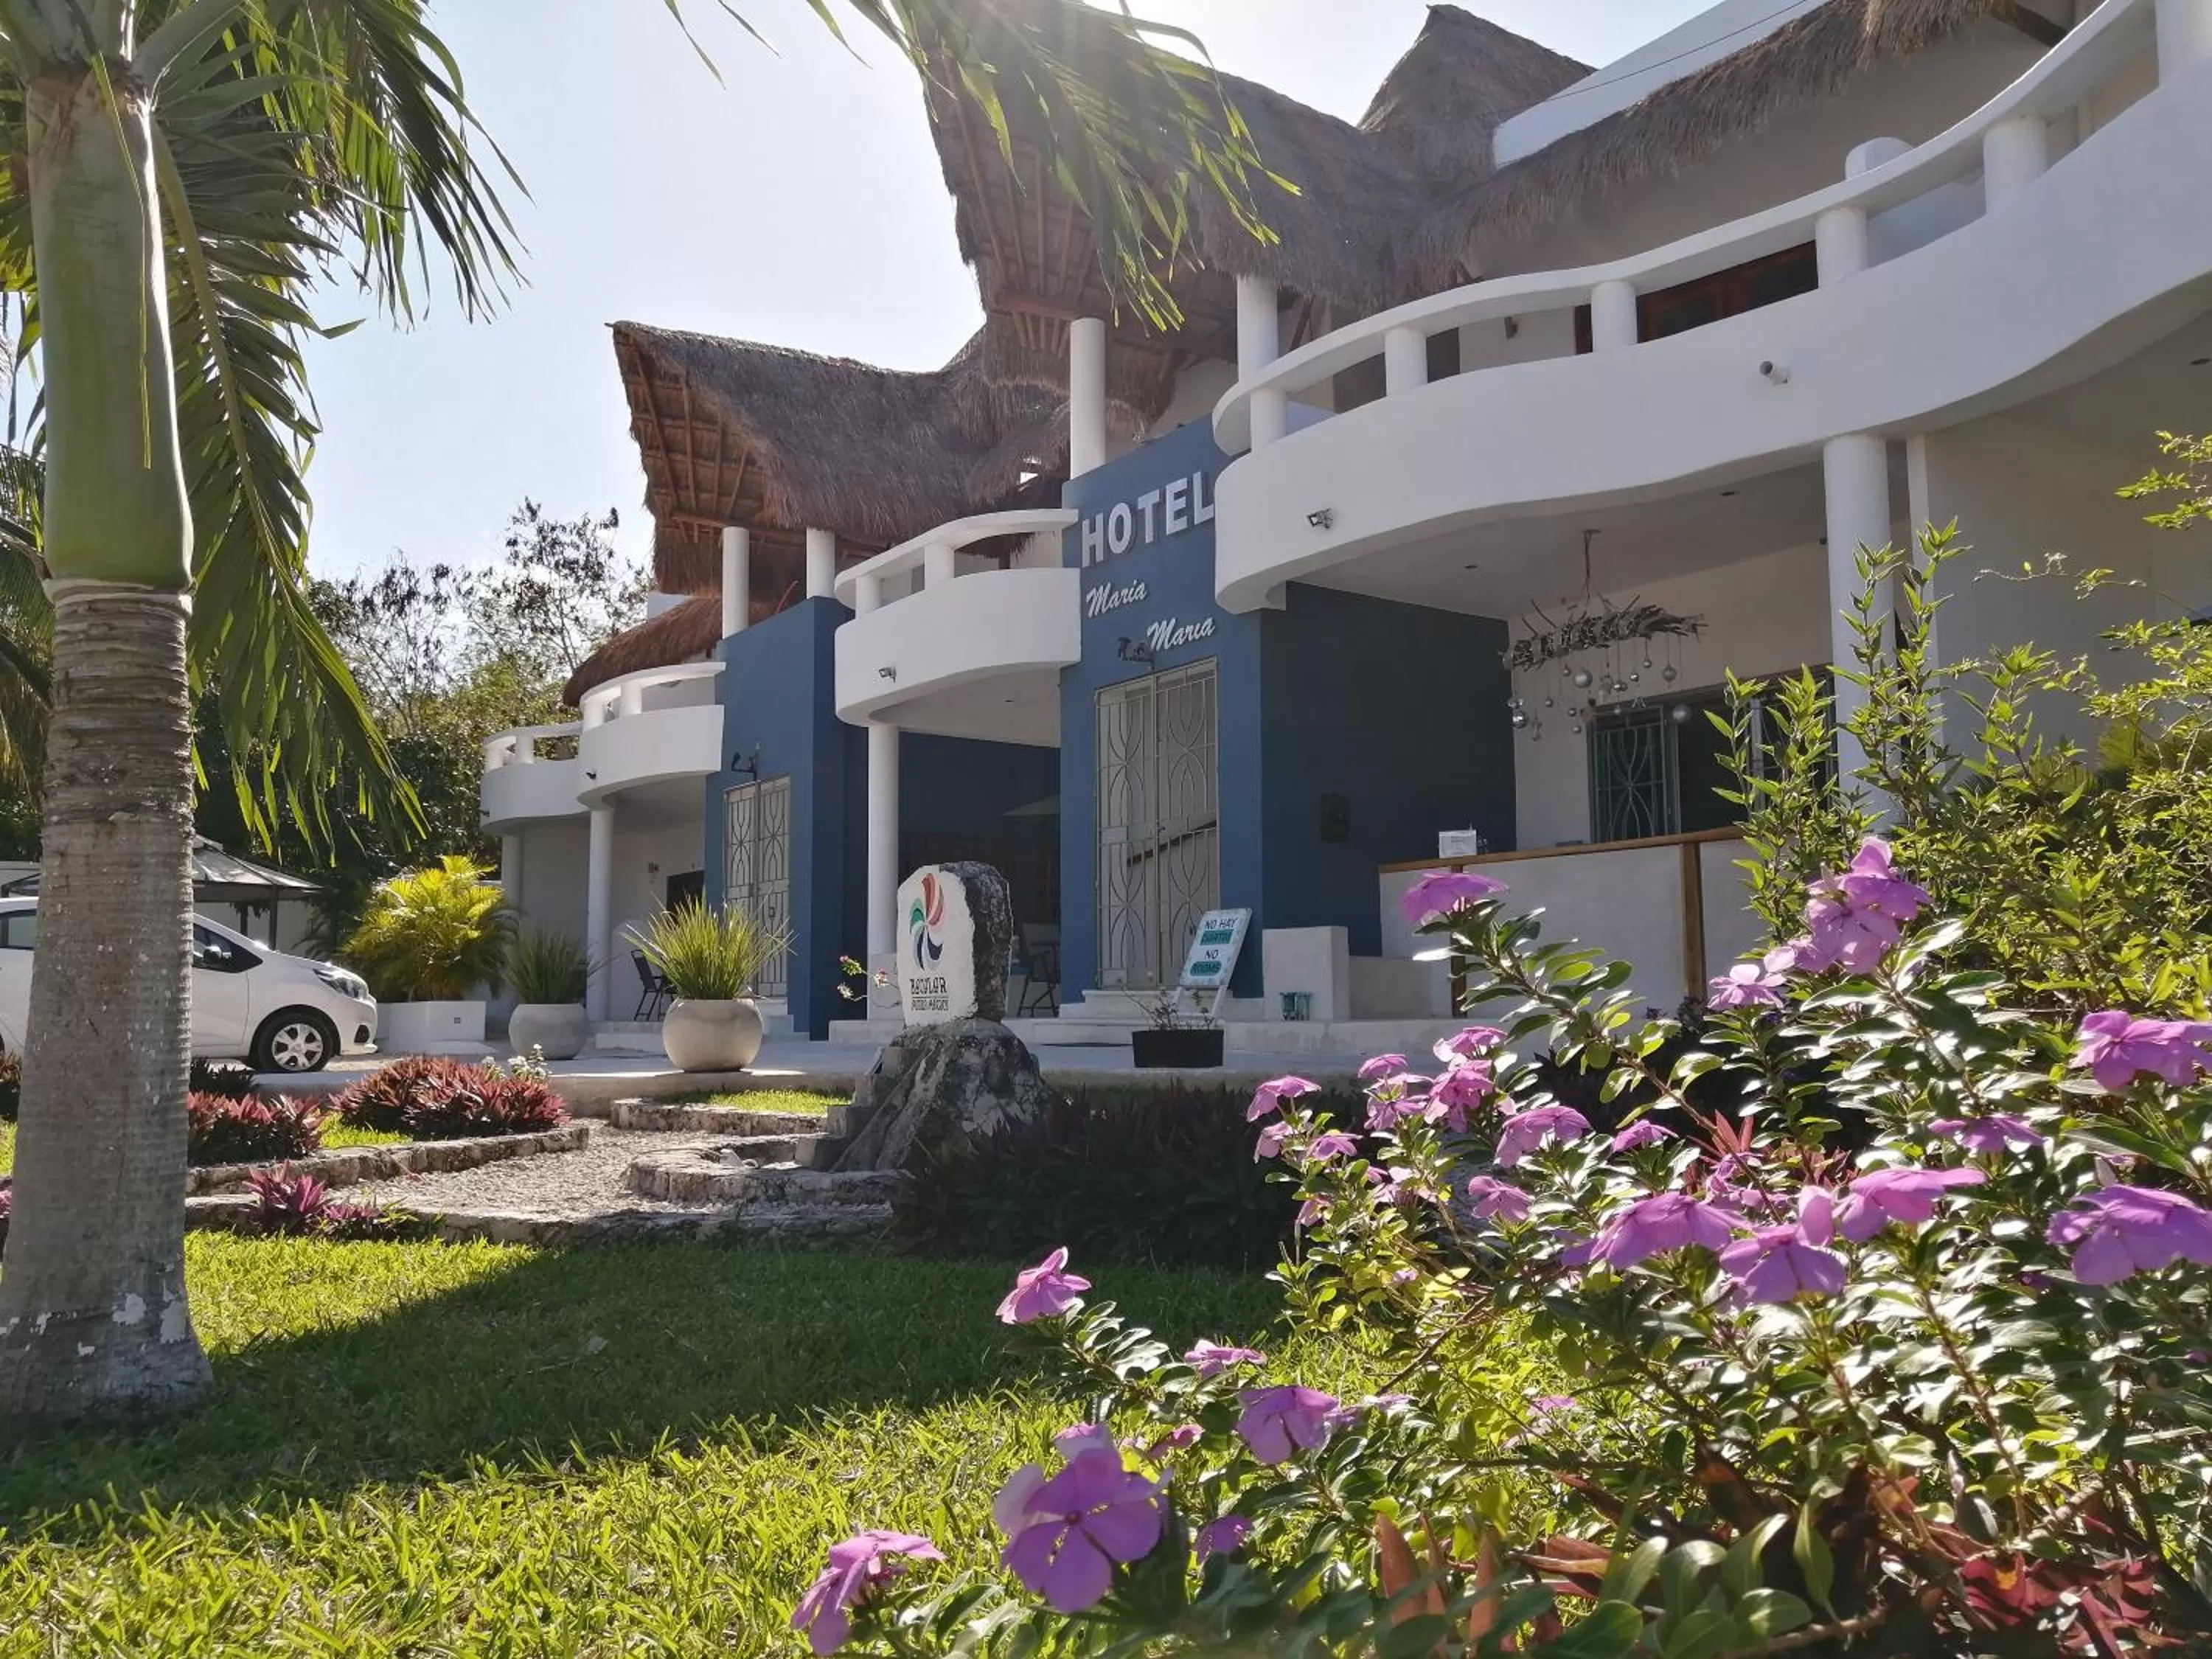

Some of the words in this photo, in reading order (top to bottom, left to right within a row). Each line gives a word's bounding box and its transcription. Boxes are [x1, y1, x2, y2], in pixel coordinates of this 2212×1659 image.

[1082, 471, 1214, 567] HOTEL
[1205, 919, 1217, 929] NO
[1205, 950, 1219, 959] NO
